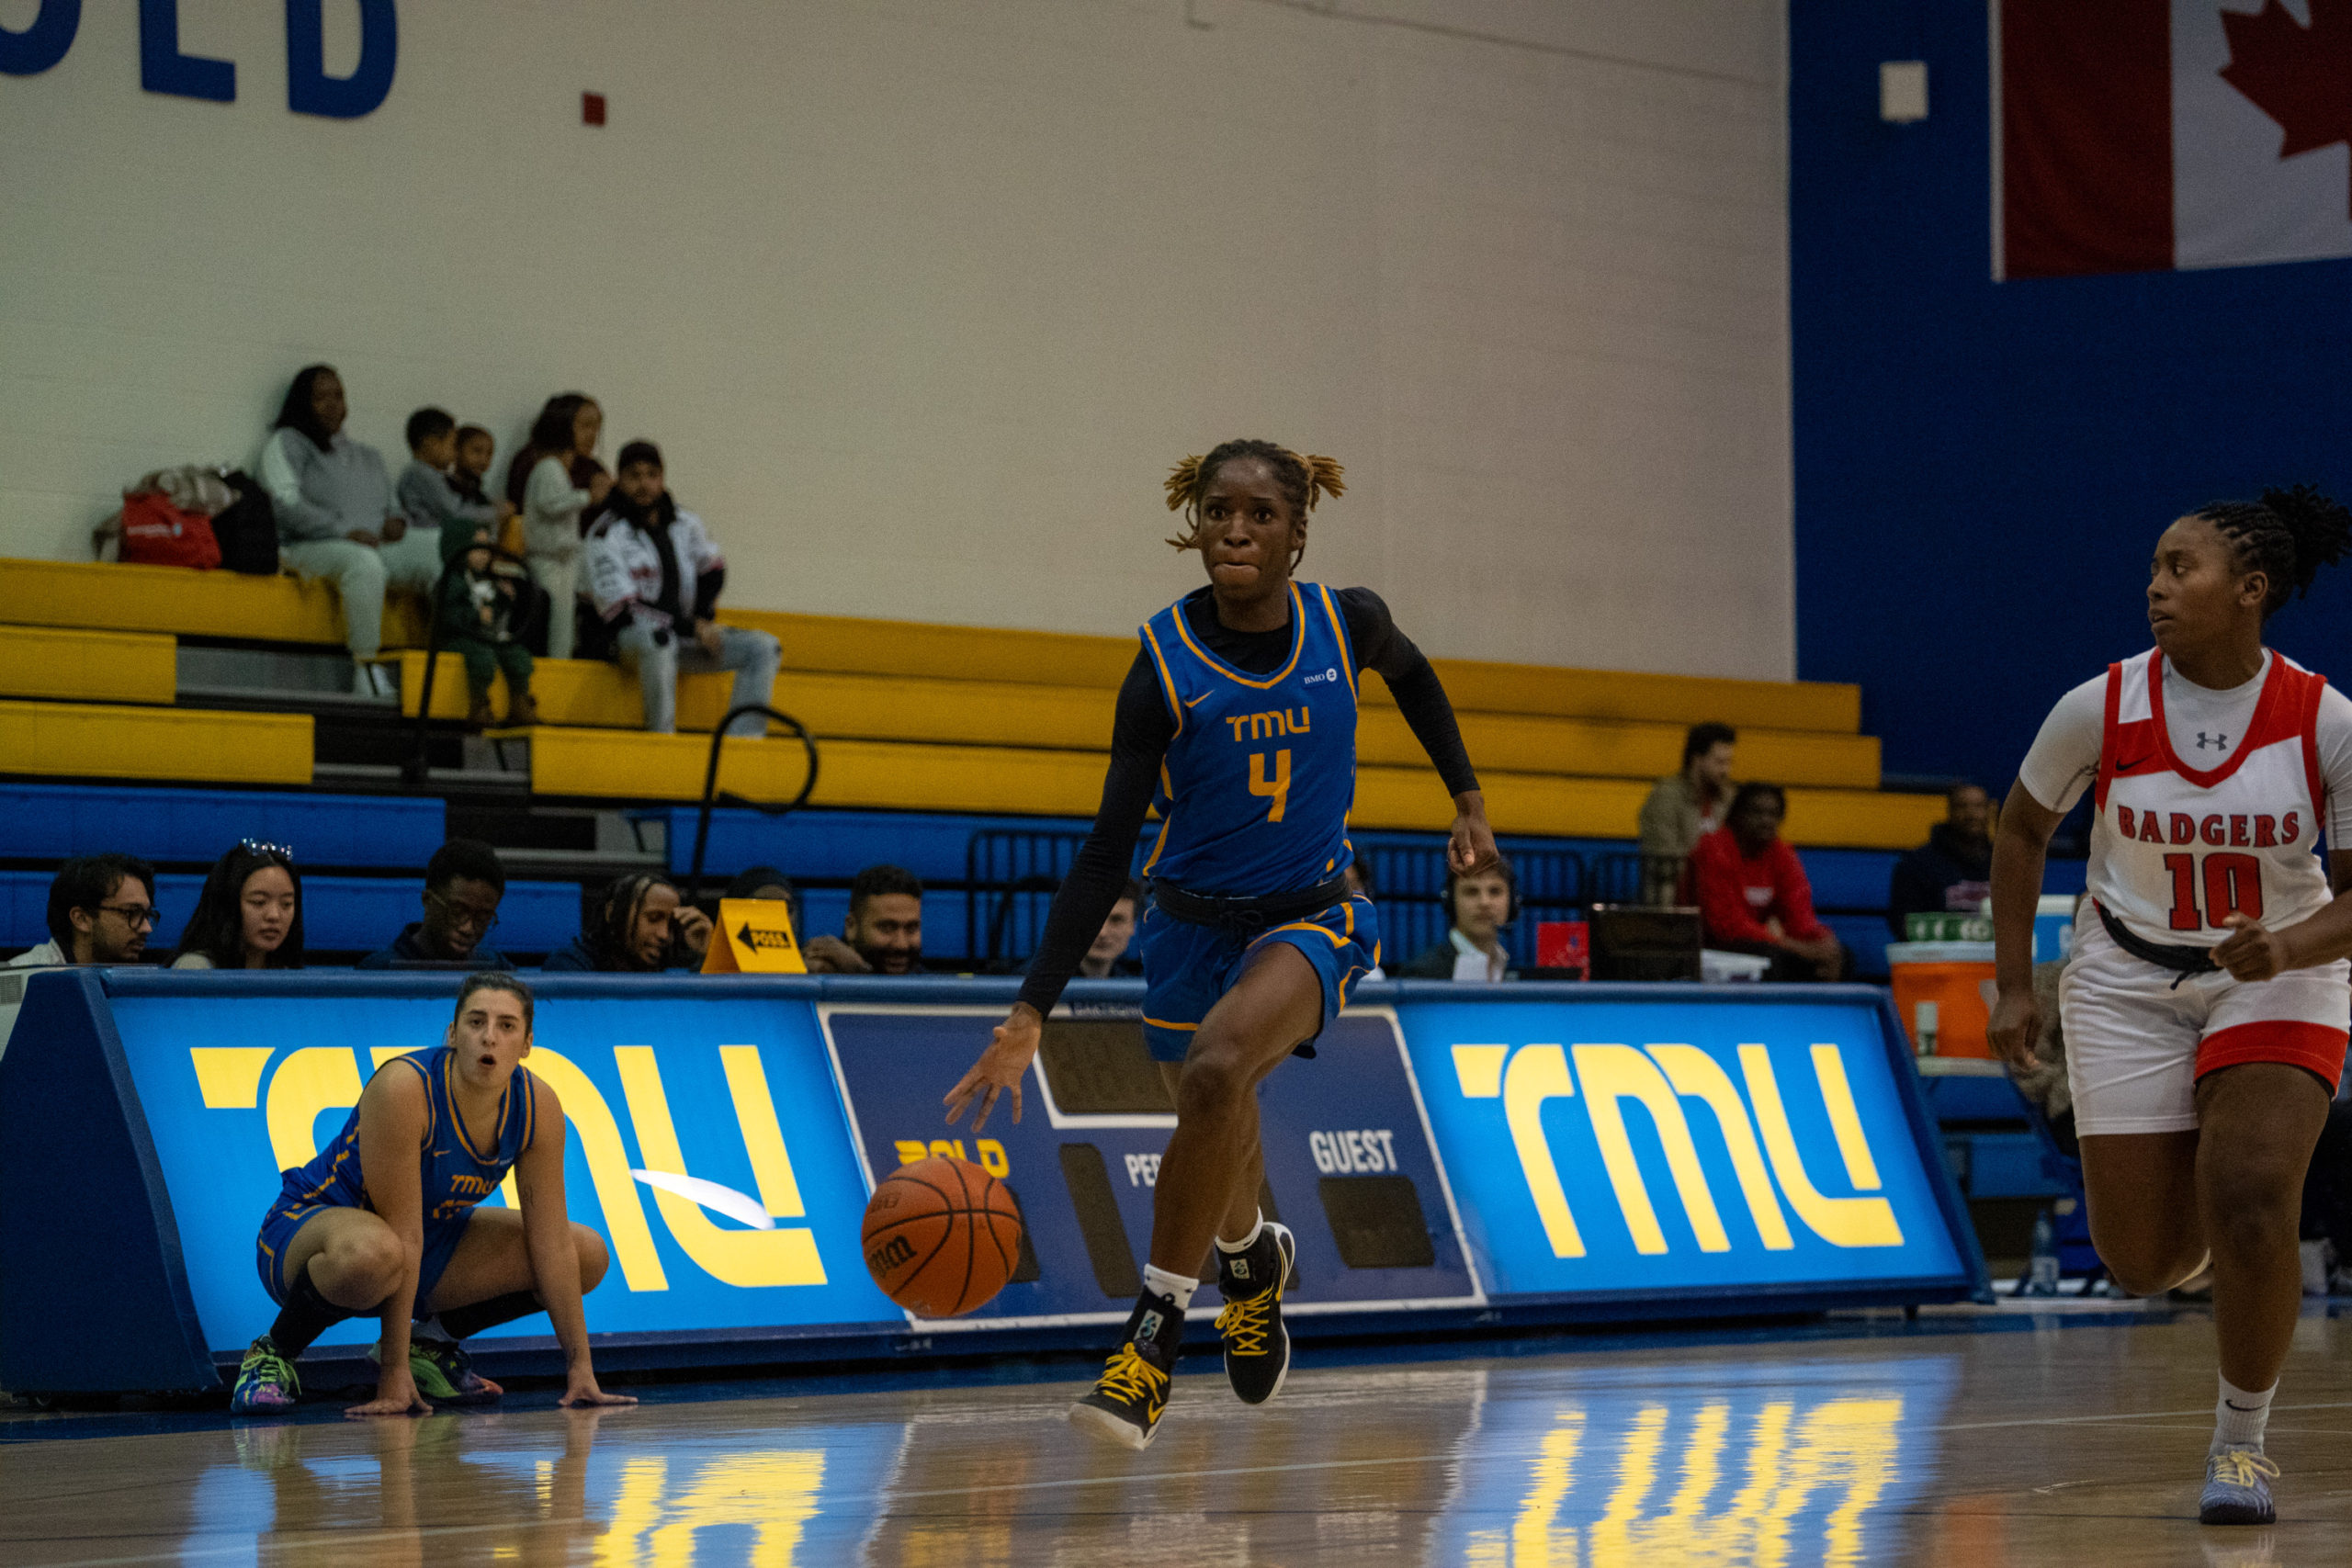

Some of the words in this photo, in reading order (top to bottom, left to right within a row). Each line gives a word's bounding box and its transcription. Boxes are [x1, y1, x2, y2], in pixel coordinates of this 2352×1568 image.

[1304, 671, 1325, 684] BMO
[1226, 706, 1310, 741] TMU
[1249, 750, 1291, 822] 4
[2118, 805, 2300, 847] BADGERS
[2164, 852, 2263, 931] 10
[1309, 1129, 1398, 1174] GUEST
[1451, 1043, 1905, 1258] TMU
